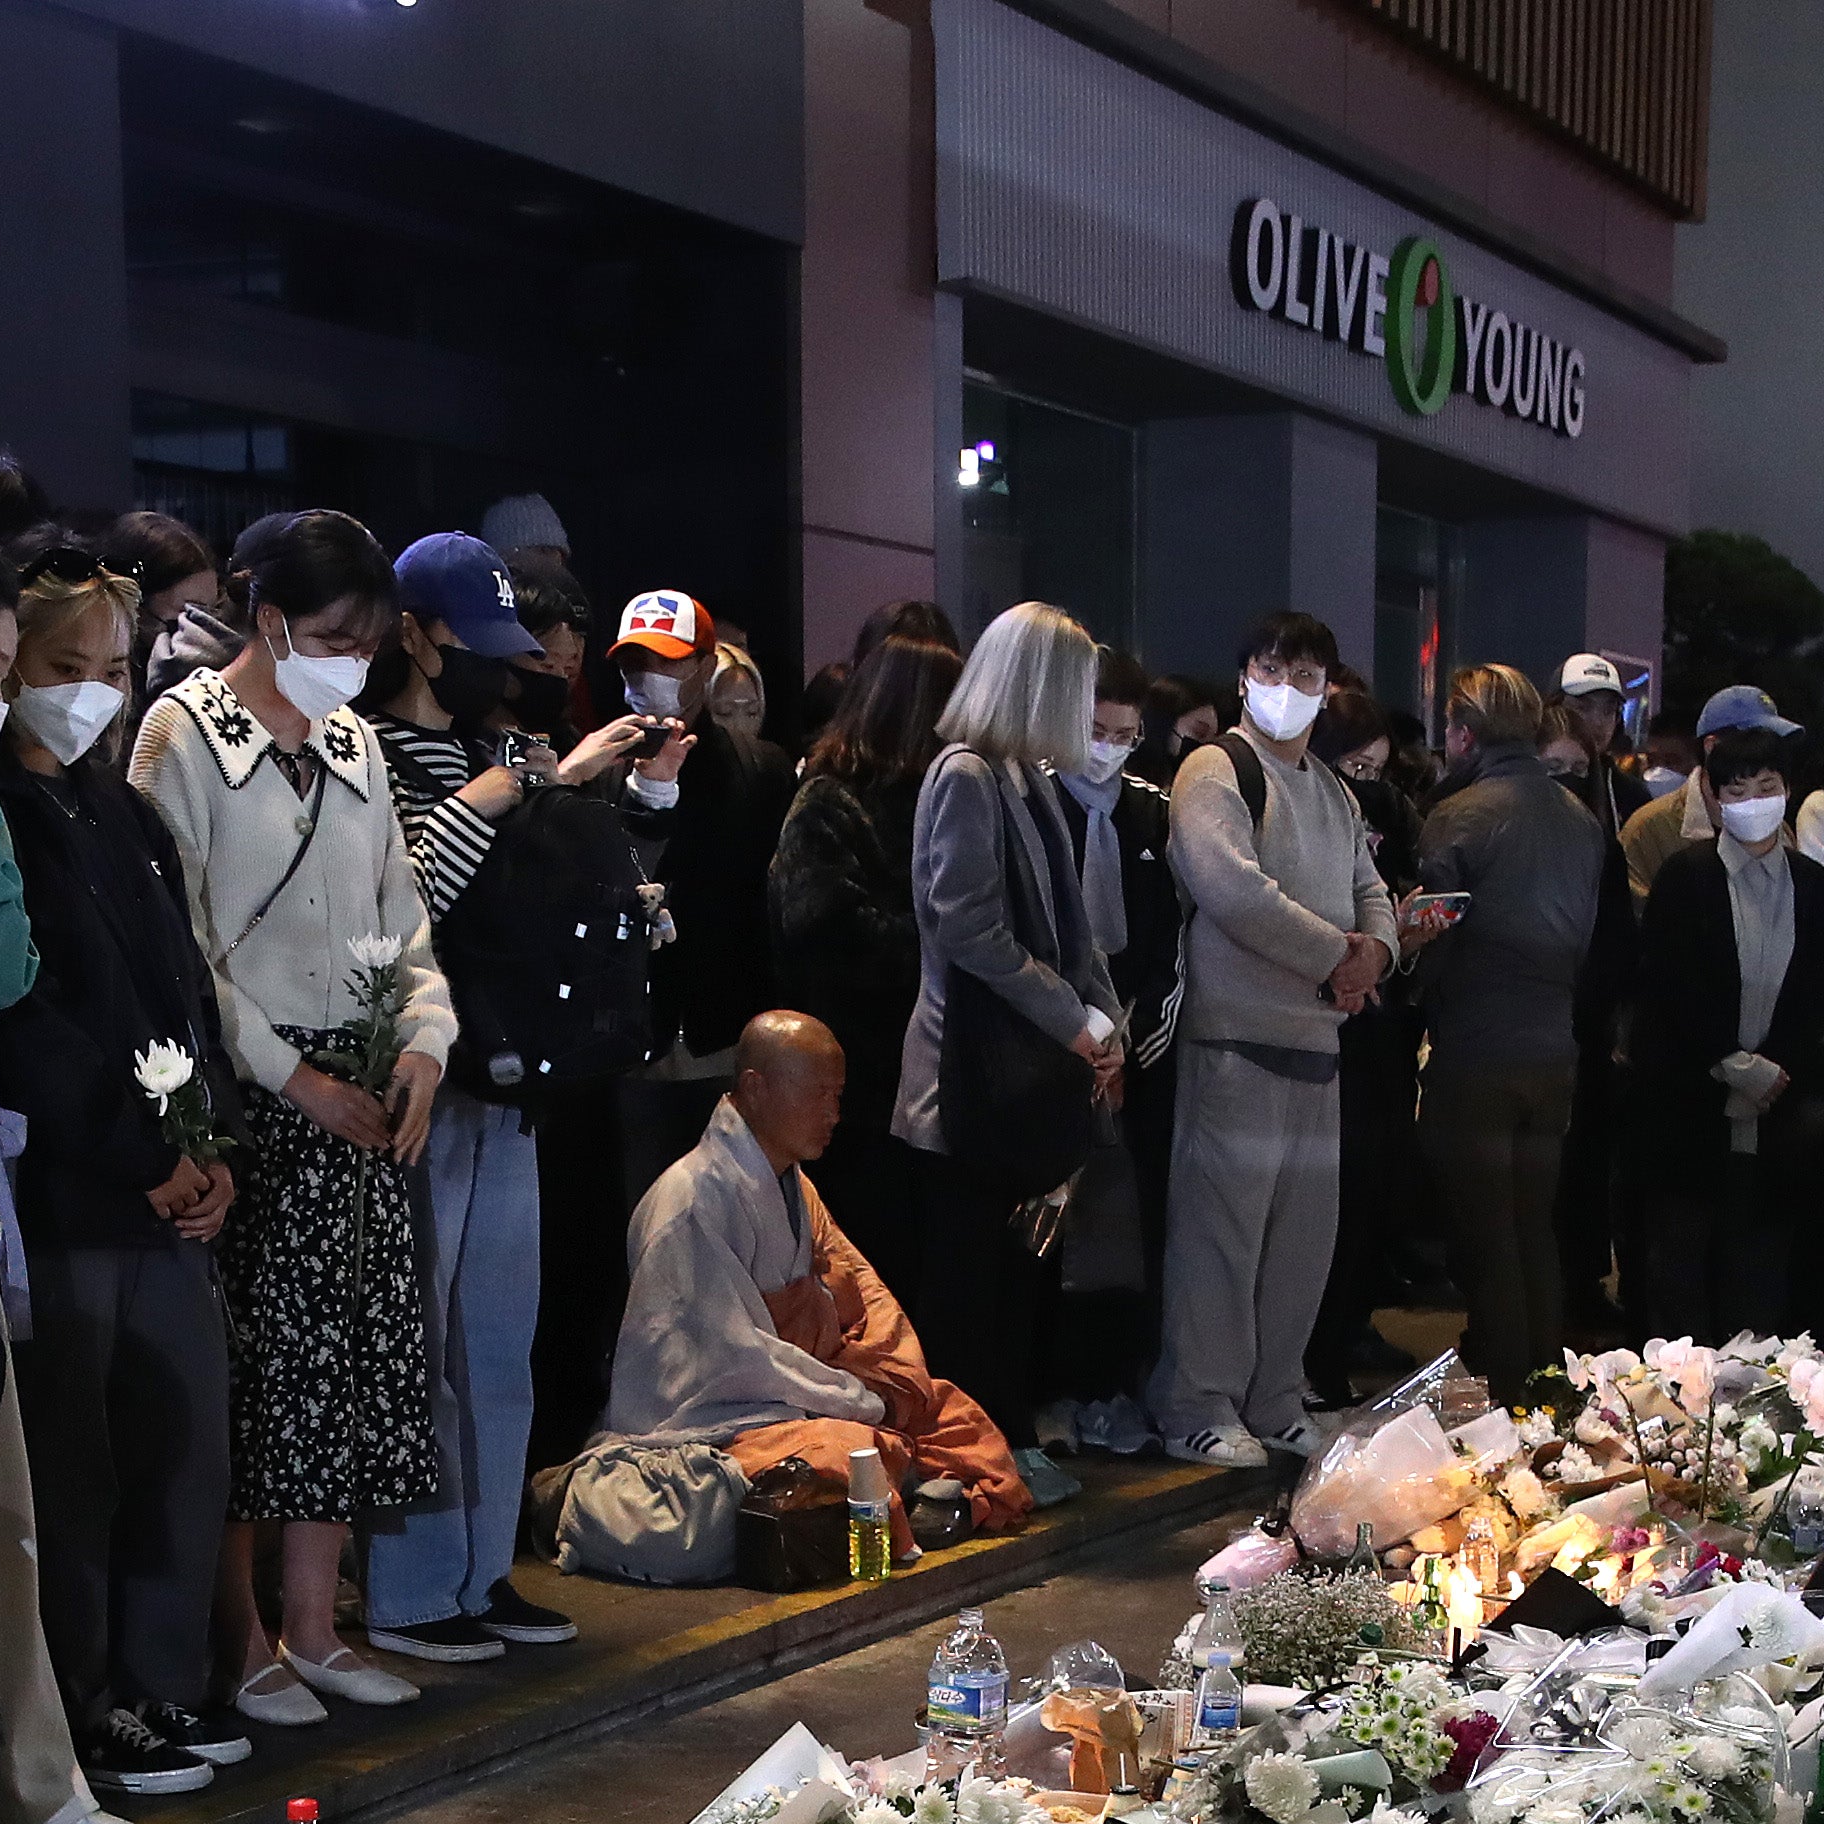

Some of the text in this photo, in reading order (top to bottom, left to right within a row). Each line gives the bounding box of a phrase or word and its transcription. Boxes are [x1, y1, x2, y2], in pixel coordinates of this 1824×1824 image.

[1236, 197, 1586, 440] OLIVE YOUNG
[492, 570, 515, 608] LA
